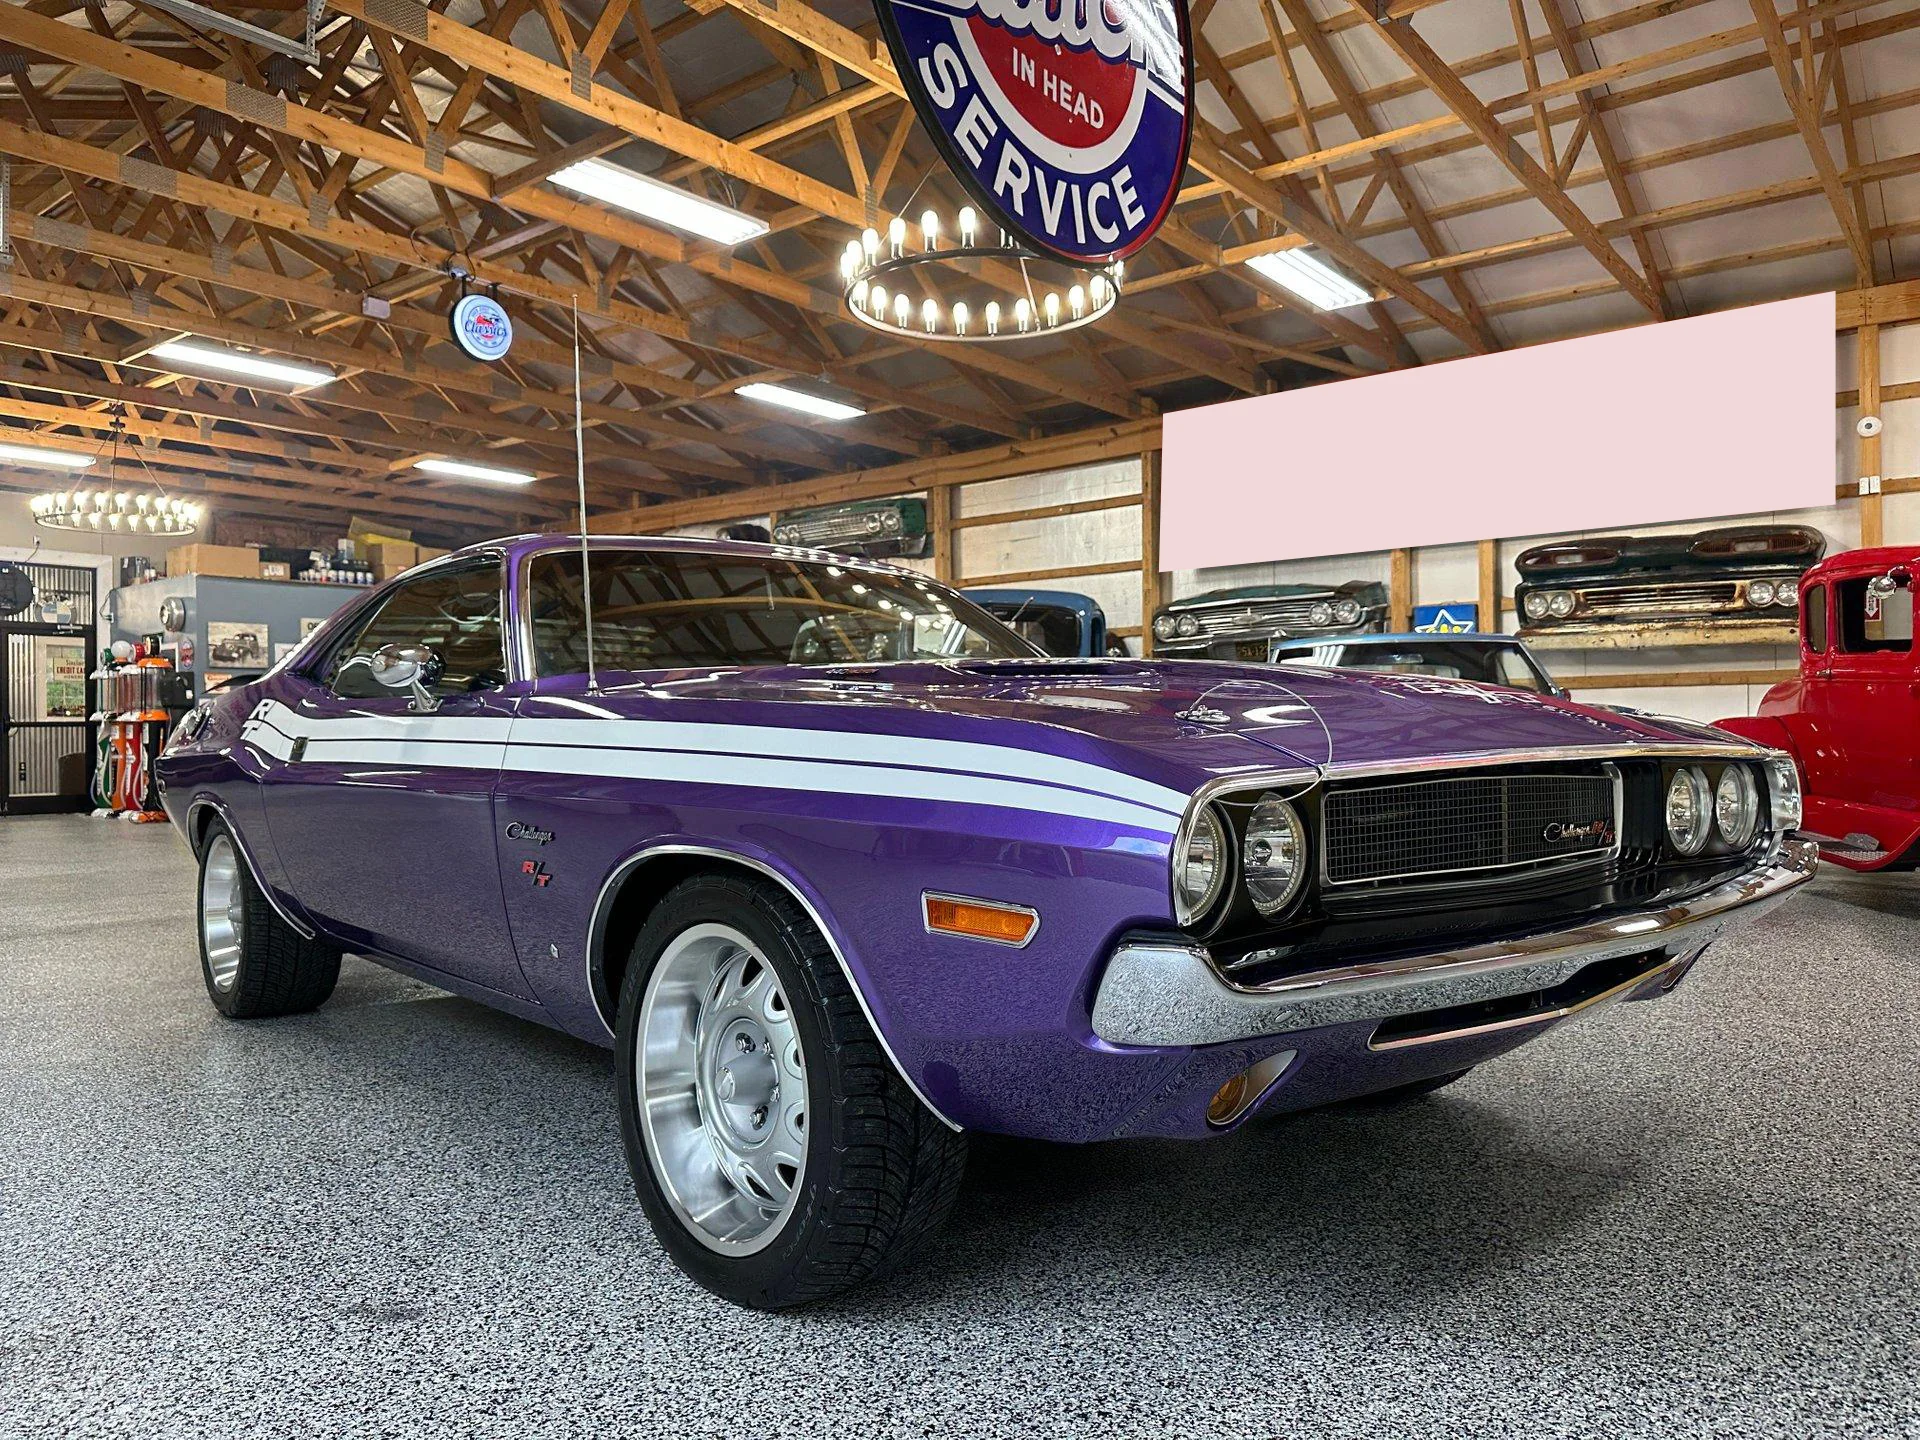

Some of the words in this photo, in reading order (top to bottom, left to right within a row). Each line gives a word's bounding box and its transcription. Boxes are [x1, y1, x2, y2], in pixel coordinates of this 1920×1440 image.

[1012, 46, 1036, 88] IN
[1043, 74, 1105, 129] HEAD
[918, 42, 1146, 244] SERVICE
[76, 666, 84, 674] CA
[506, 822, 552, 845] Challenger
[522, 861, 551, 887] R/T
